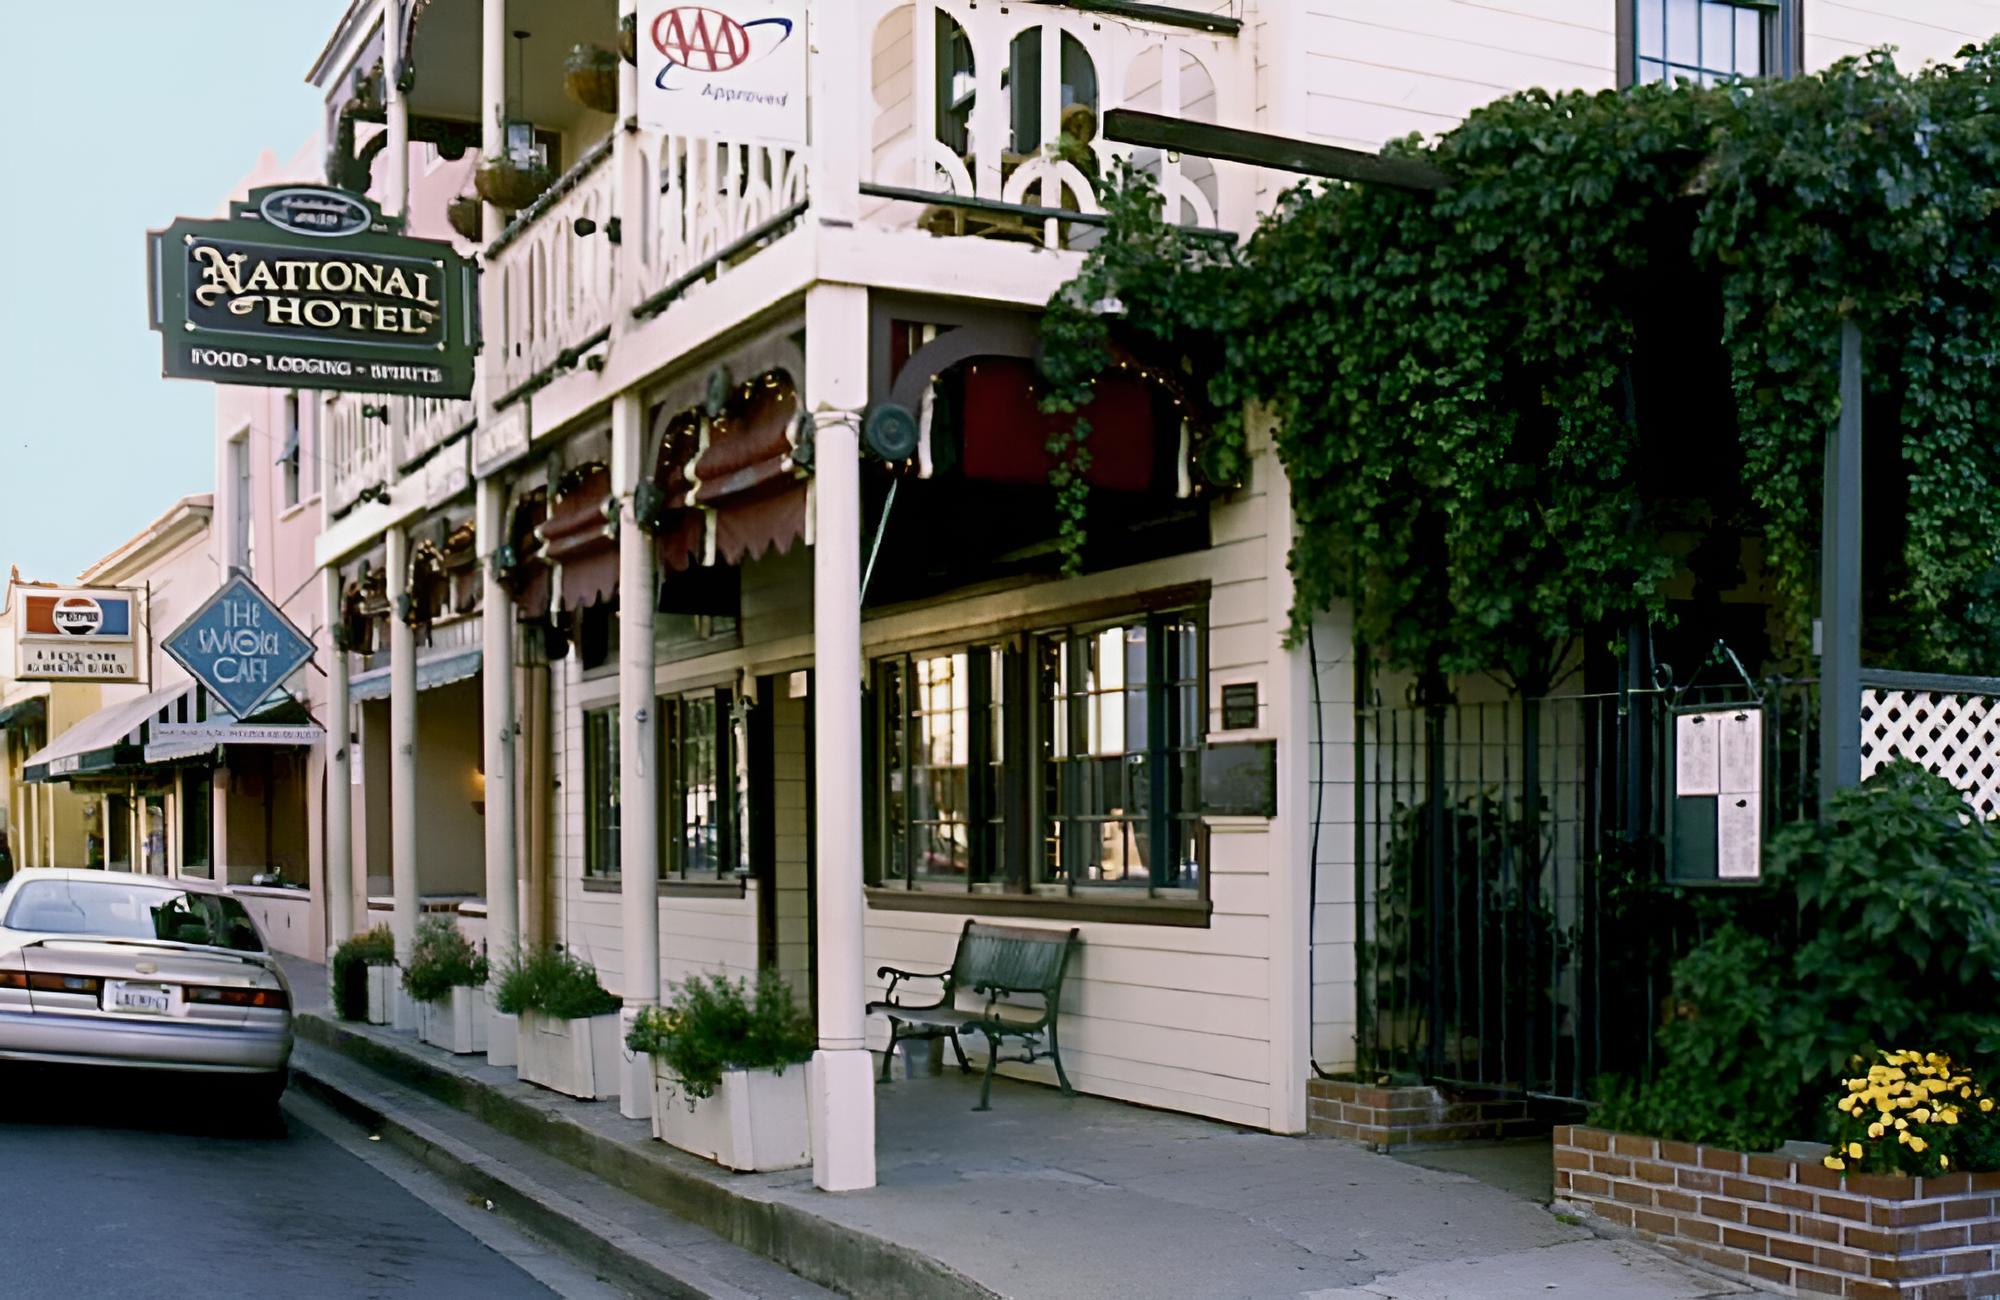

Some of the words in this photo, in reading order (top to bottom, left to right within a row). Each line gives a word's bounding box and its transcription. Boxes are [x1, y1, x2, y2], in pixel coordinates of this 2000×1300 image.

[663, 8, 738, 71] AAA
[193, 246, 439, 308] NATIONAL
[227, 295, 427, 334] HOTEL
